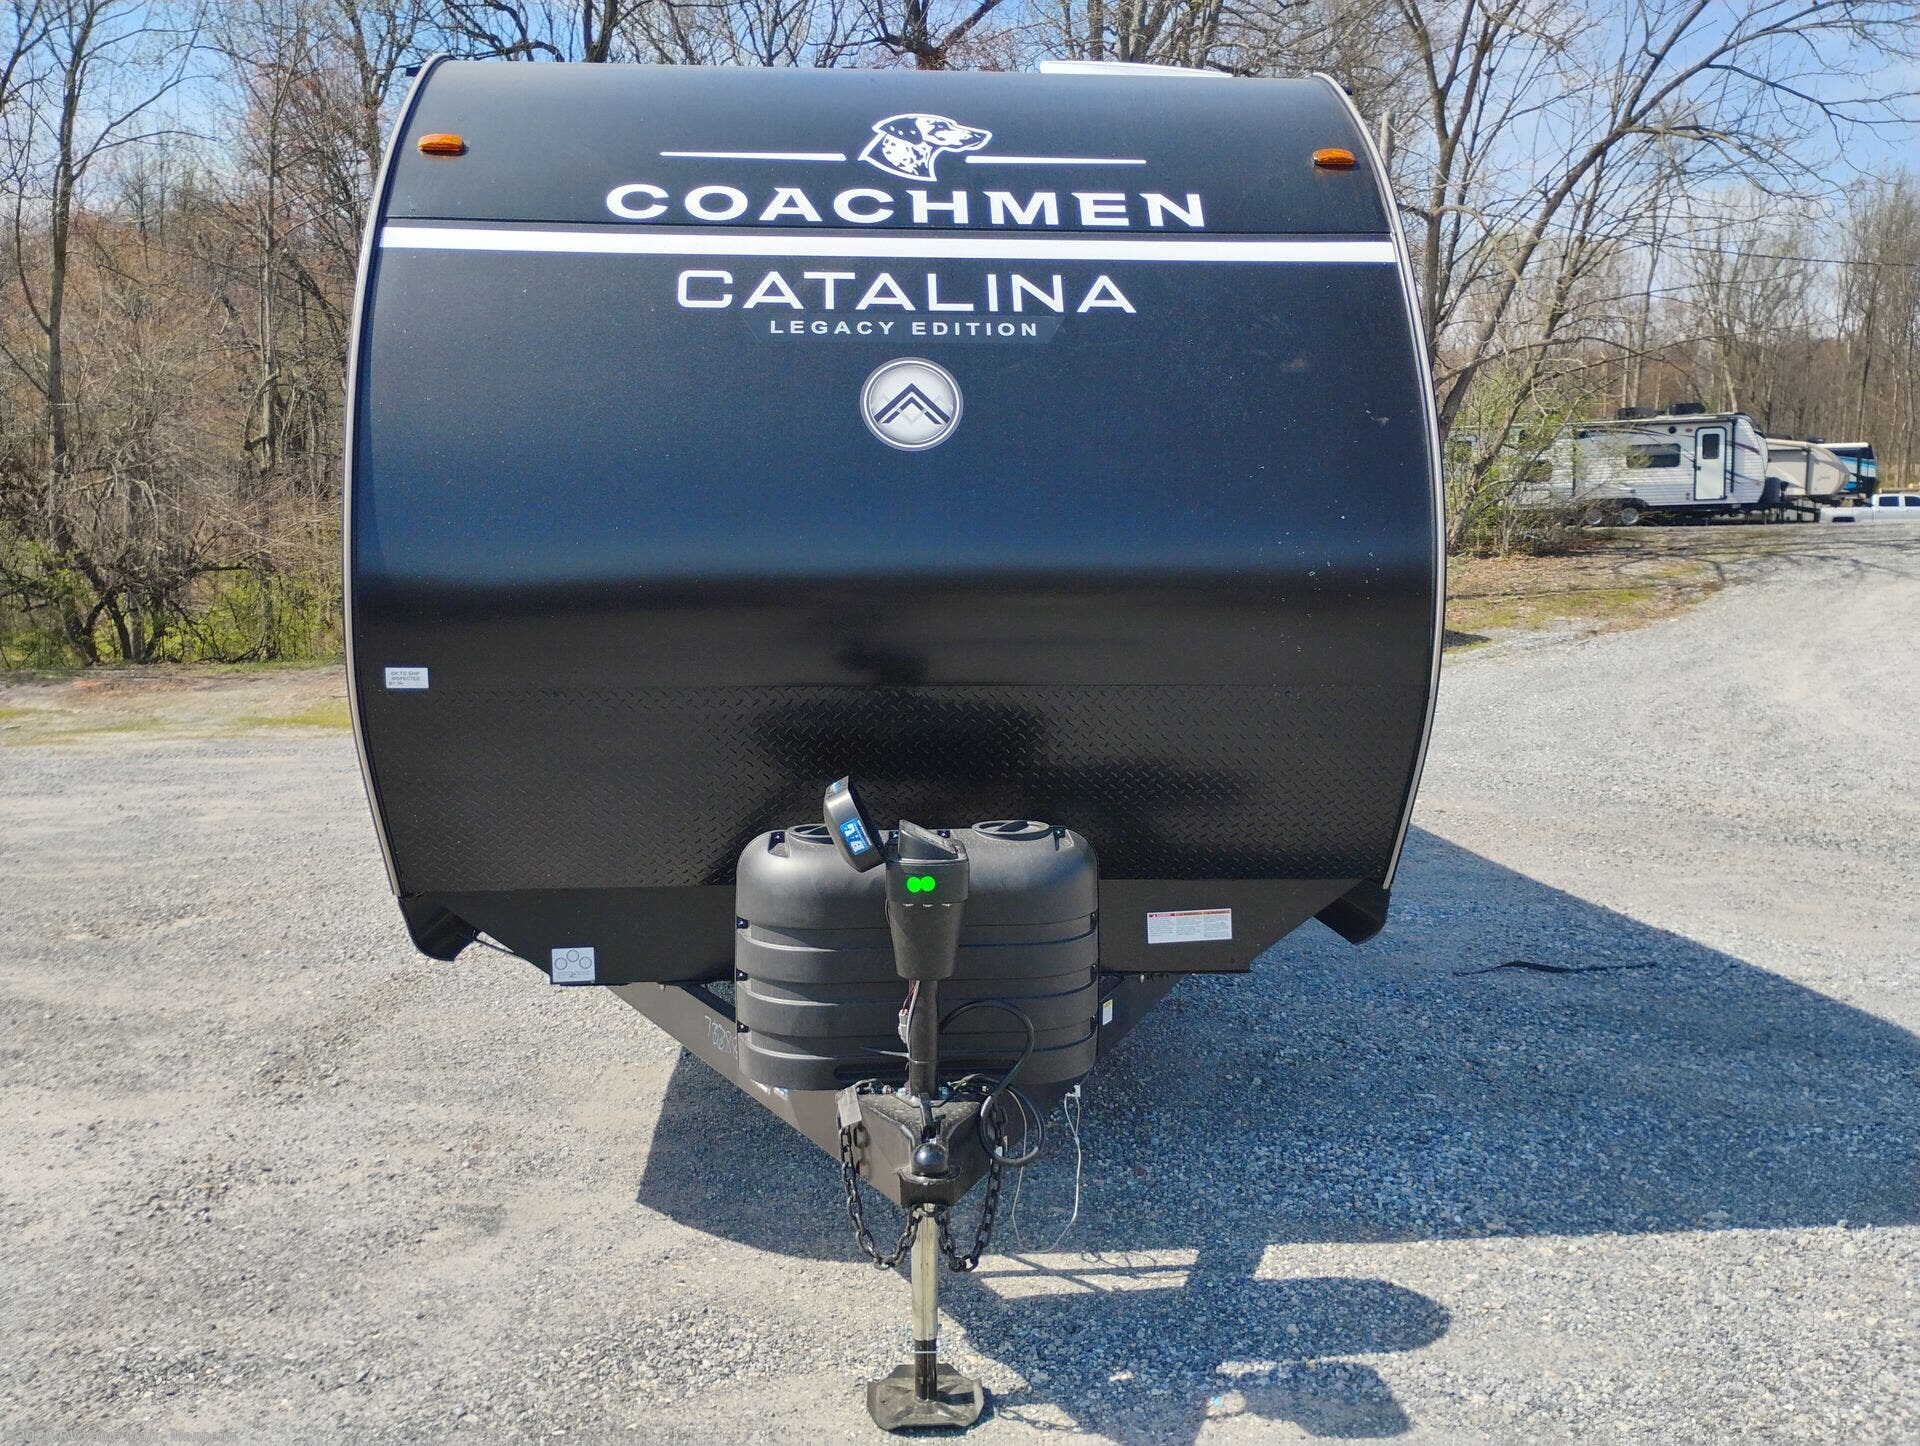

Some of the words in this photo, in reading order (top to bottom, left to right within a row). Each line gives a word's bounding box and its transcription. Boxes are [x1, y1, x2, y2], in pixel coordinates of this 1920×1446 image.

[606, 183, 1206, 227] COACHMEN
[677, 269, 1138, 314] CATALINA
[769, 319, 895, 336] LEGACY
[910, 320, 1038, 338] EDITION
